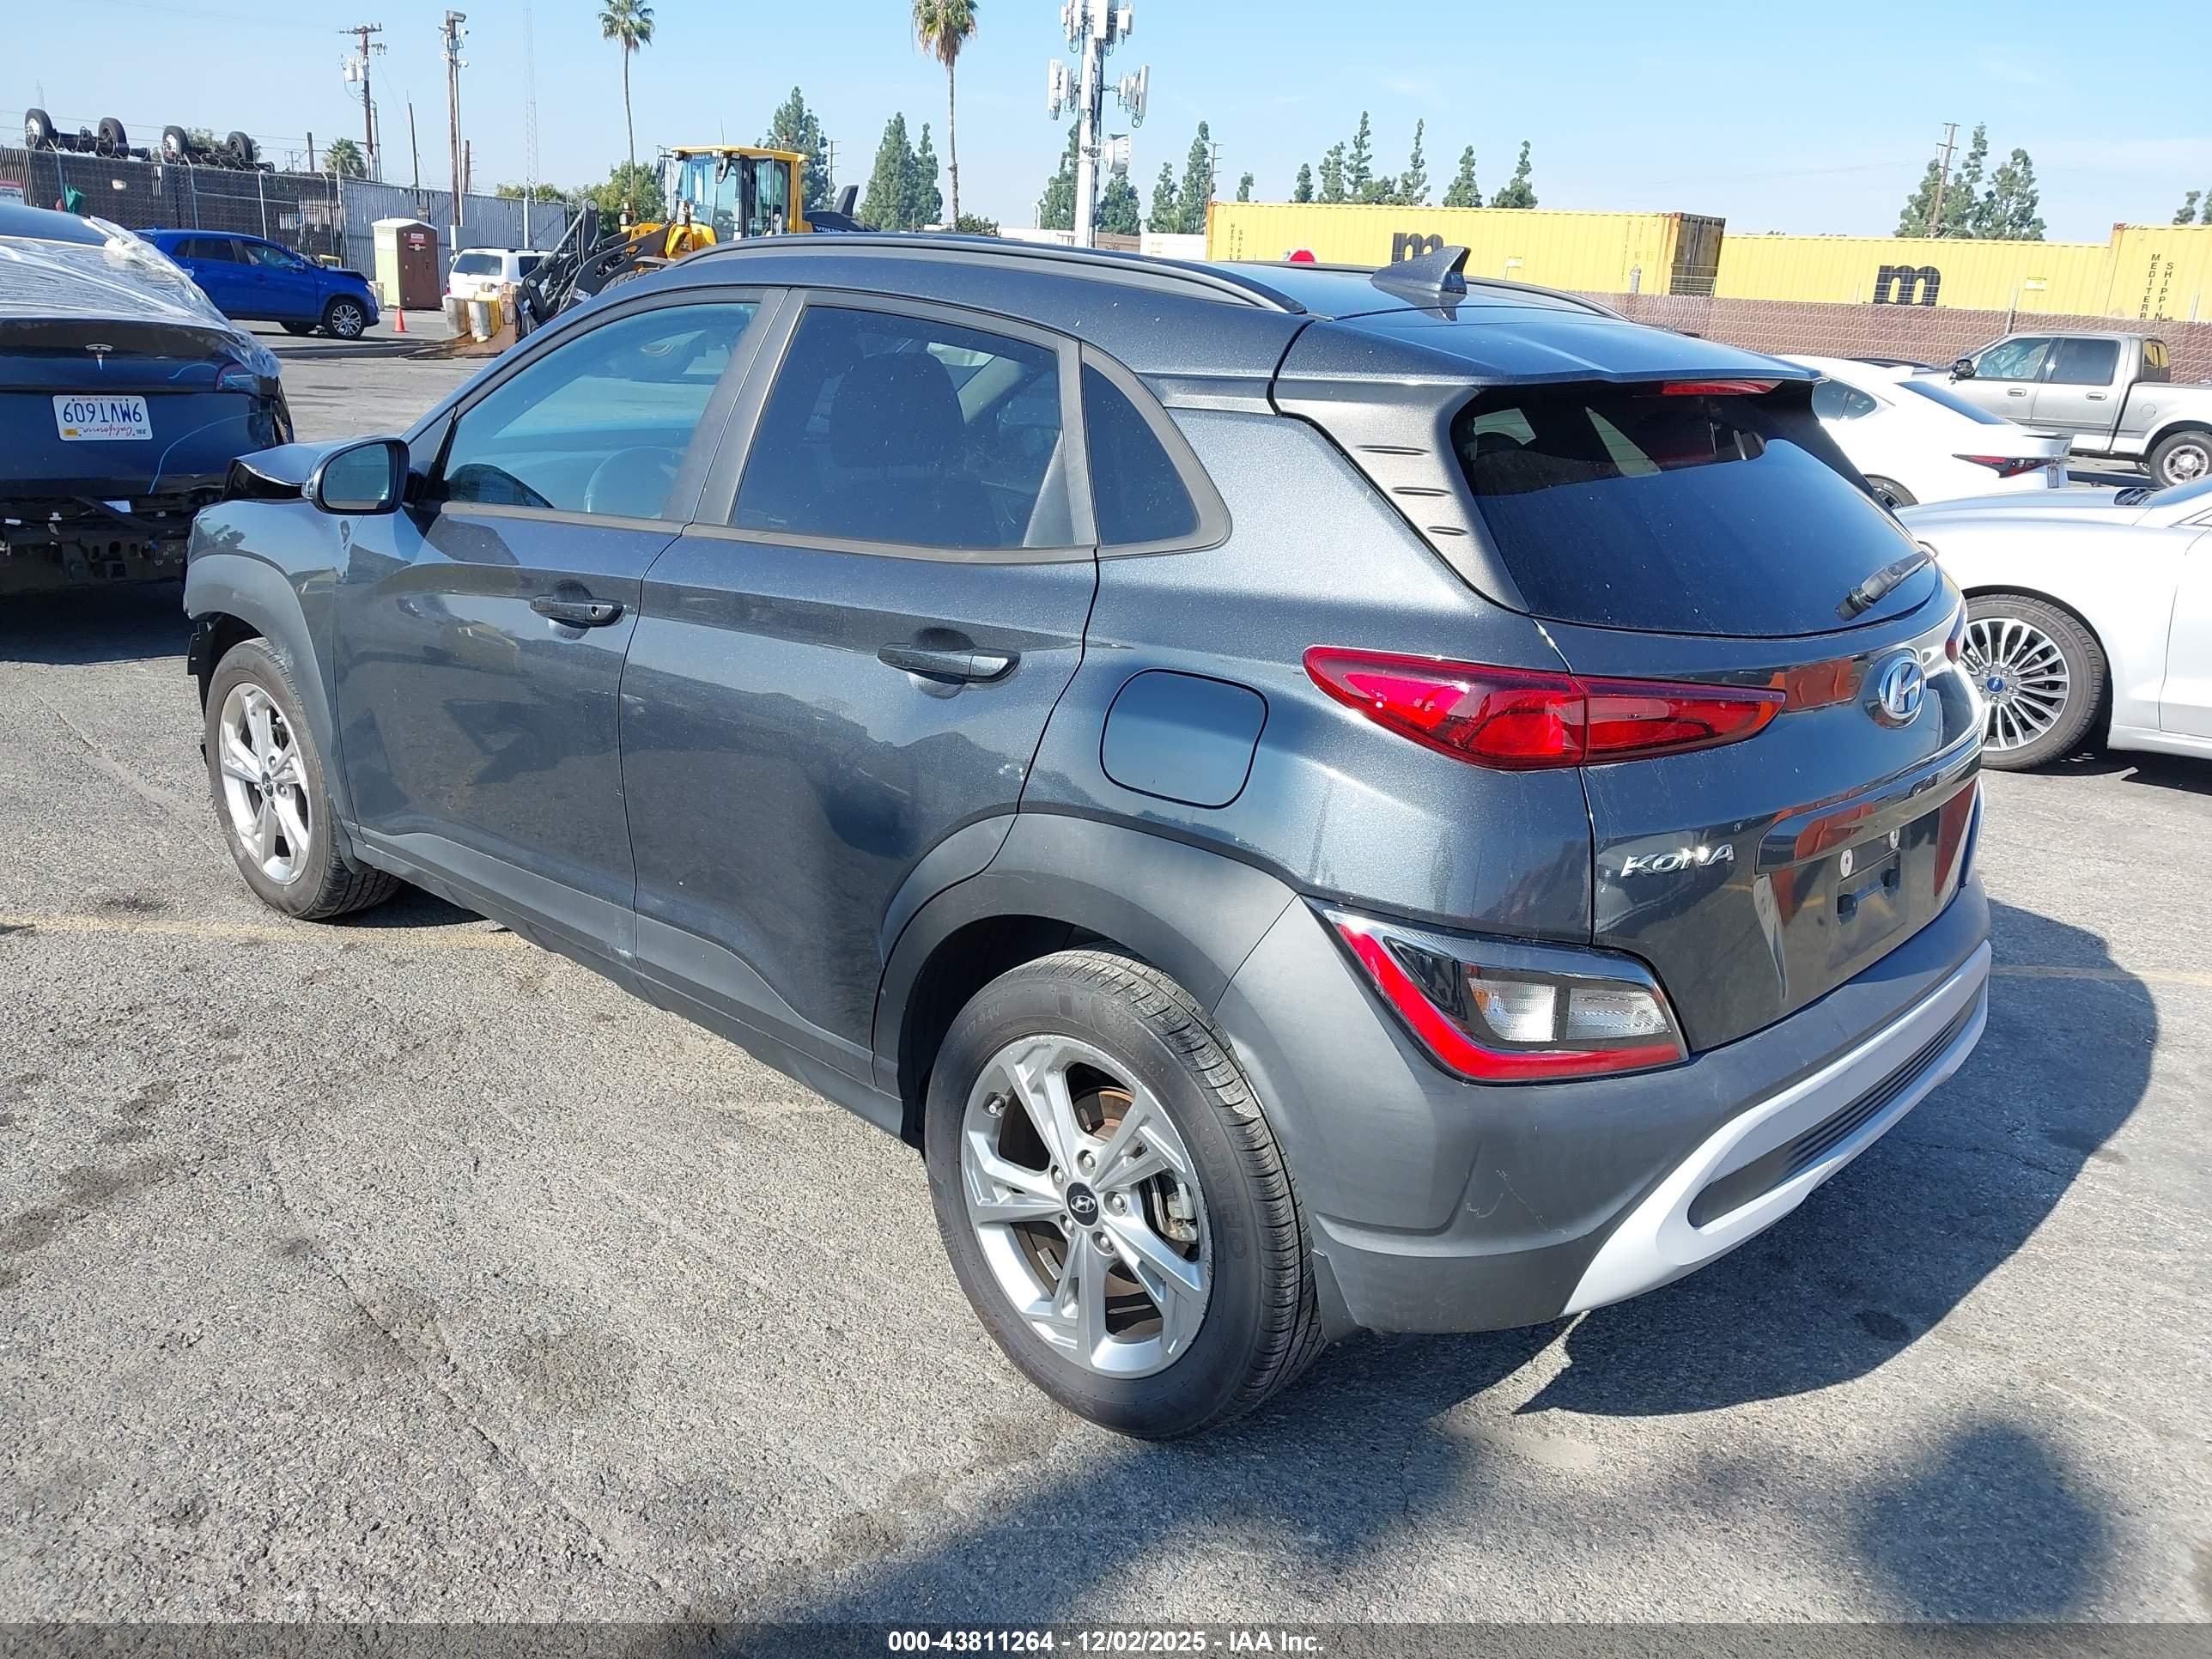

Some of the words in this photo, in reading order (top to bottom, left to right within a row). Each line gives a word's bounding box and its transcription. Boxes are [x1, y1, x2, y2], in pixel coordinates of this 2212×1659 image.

[63, 403, 143, 422] 9MVT609
[76, 424, 132, 436] California
[1621, 843, 1735, 878] KONA
